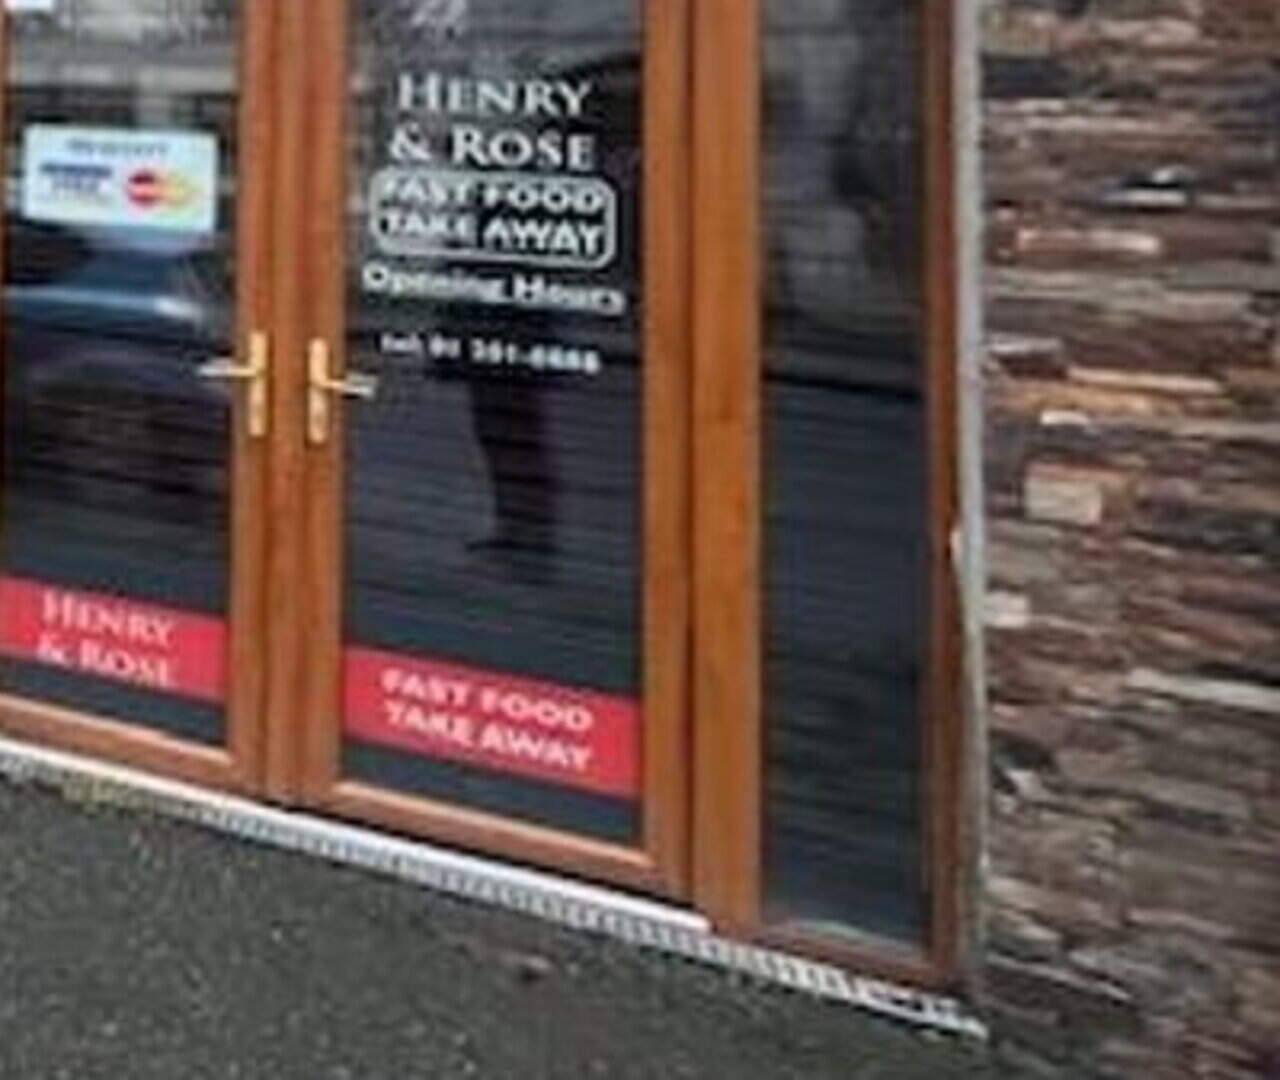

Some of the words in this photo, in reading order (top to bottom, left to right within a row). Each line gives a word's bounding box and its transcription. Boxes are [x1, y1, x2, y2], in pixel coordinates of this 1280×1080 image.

[397, 72, 592, 117] HENRY
[389, 123, 433, 162] &
[450, 123, 595, 170] ROSE
[482, 182, 605, 213] FOOD
[482, 219, 604, 255] AWAY
[42, 590, 174, 650] HENRY
[80, 637, 173, 688] ROSE
[381, 666, 469, 705] FAST
[480, 686, 595, 731] FOOD
[383, 698, 474, 746] TAKE
[478, 722, 595, 772] AWAY
